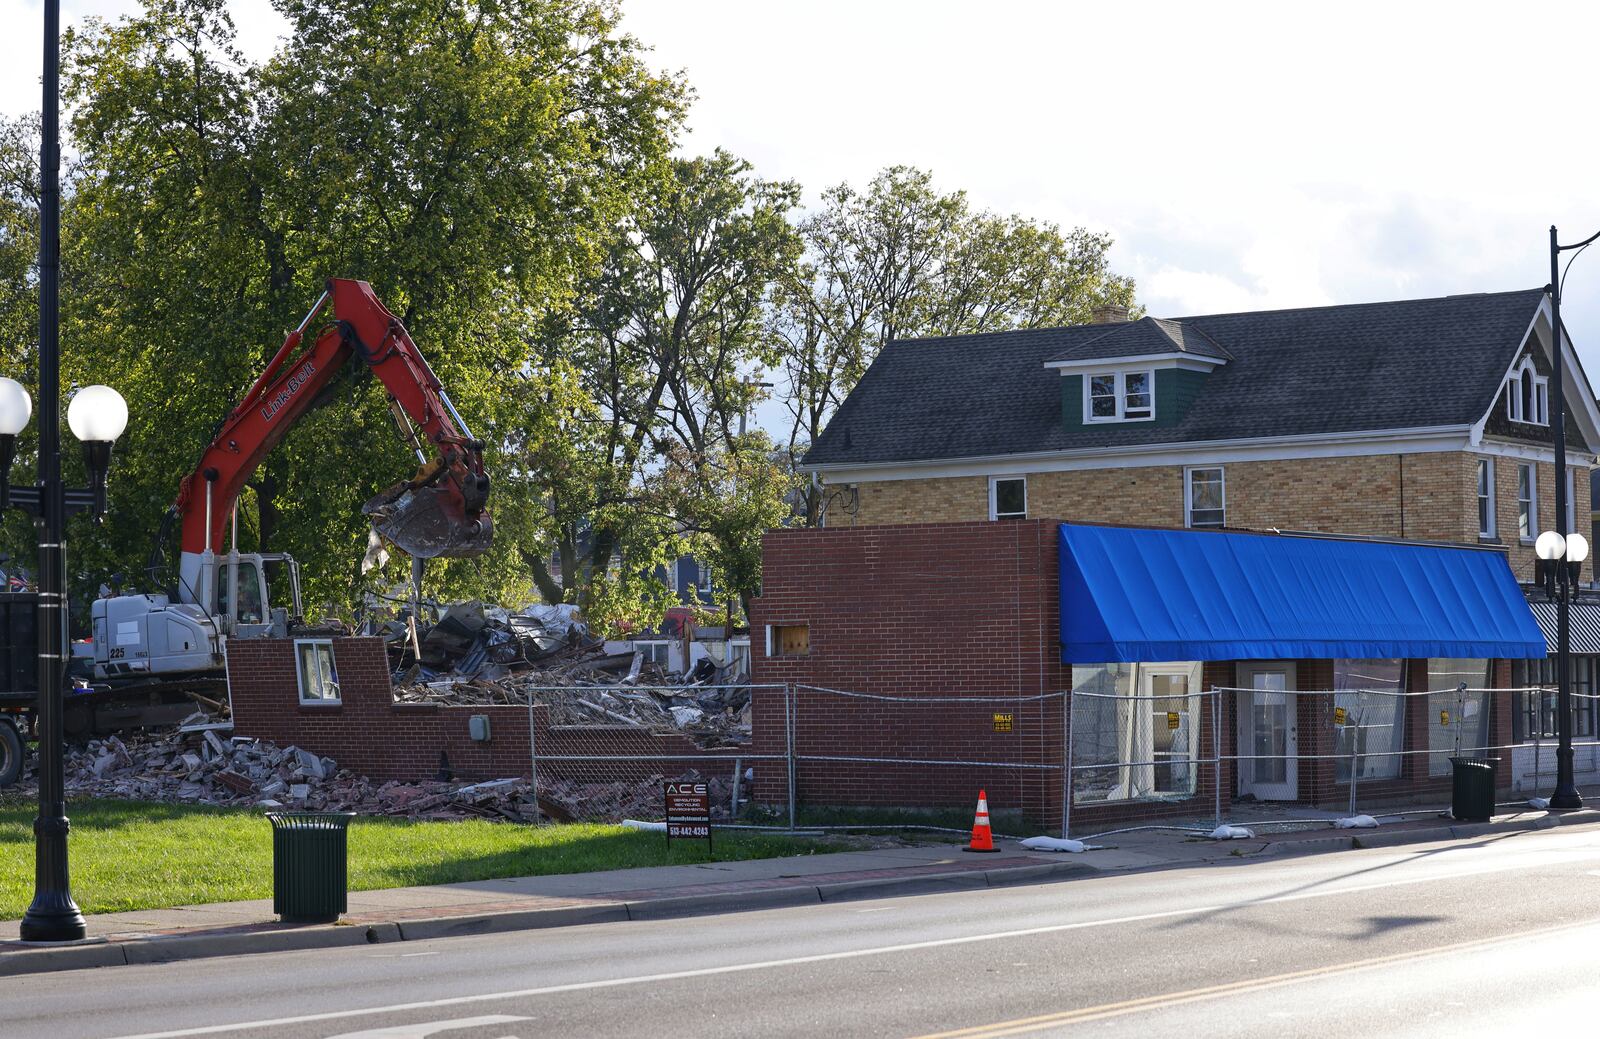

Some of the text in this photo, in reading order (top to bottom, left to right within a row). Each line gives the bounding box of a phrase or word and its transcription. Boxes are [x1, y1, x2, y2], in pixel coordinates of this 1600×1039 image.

[261, 361, 316, 422] Link-Belt
[110, 648, 125, 659] 225
[666, 784, 707, 794] ACE
[670, 826, 708, 836] 513-442-4243
